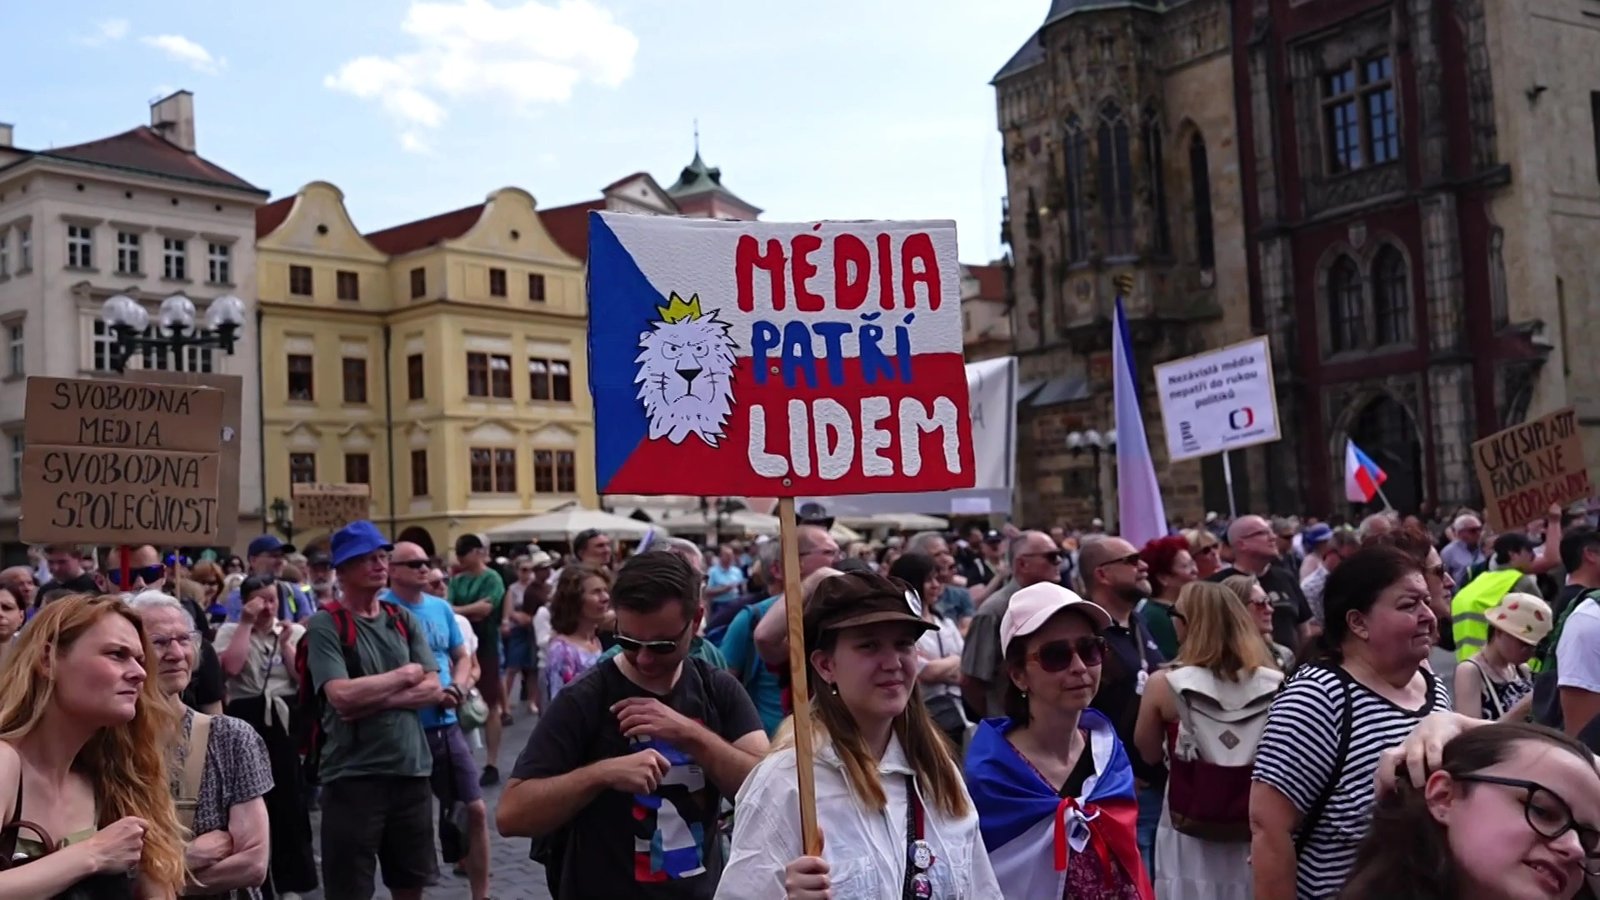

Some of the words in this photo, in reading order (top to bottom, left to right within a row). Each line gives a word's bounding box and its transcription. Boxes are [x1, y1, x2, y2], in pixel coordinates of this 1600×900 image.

[735, 223, 942, 312] MÉDIA
[751, 312, 915, 389] PATŘÍ
[1167, 364, 1218, 385] Nezávislá
[1221, 355, 1255, 371] média
[51, 382, 200, 415] SVOBODNÁ
[1210, 378, 1223, 390] do
[1226, 370, 1258, 384] rukou
[747, 396, 962, 480] LIDEM
[42, 452, 208, 488] SVOBODNÁ
[1489, 461, 1536, 498] FAKTA
[1537, 445, 1566, 479] NE
[52, 488, 217, 535] SPOLEČNOST
